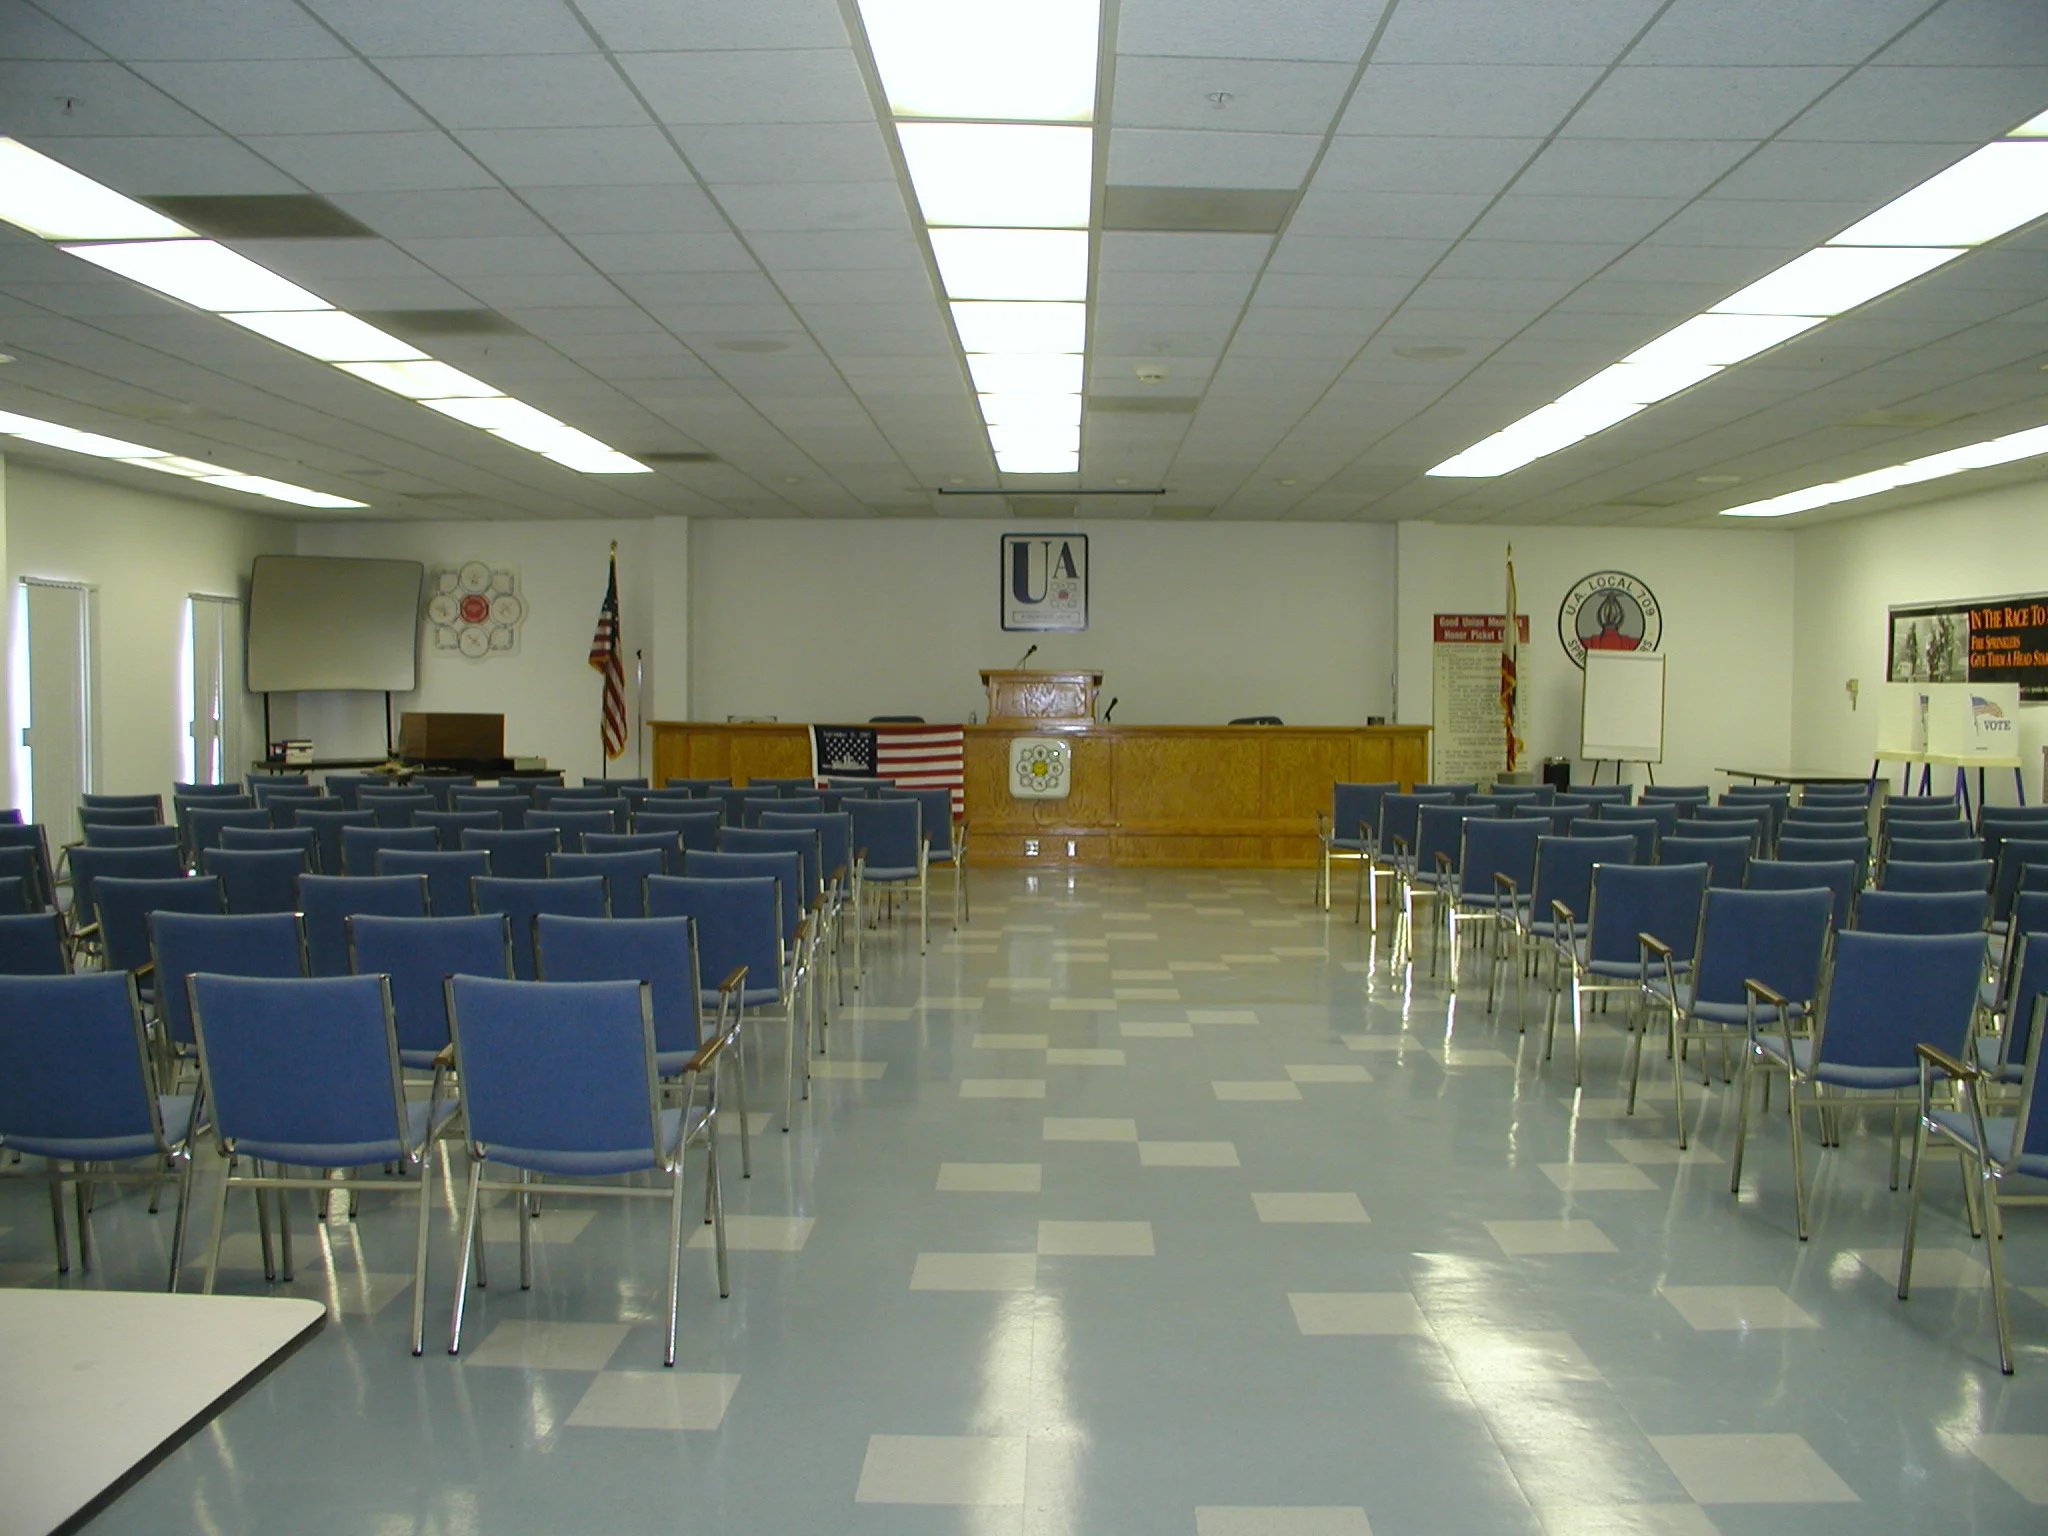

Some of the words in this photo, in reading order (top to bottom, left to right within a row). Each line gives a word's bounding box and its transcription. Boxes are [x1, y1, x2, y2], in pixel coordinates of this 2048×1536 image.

[1010, 541, 1080, 604] UA
[1588, 576, 1632, 592] LOCAL
[1636, 590, 1656, 617] 709
[1439, 616, 1459, 627] Good
[1971, 609, 1981, 629] IN
[1983, 608, 2003, 629] THE
[2005, 606, 2030, 628] RACE
[2031, 604, 2046, 626] TO
[2013, 650, 2033, 666] HEAD
[1983, 719, 2011, 731] VOTE
